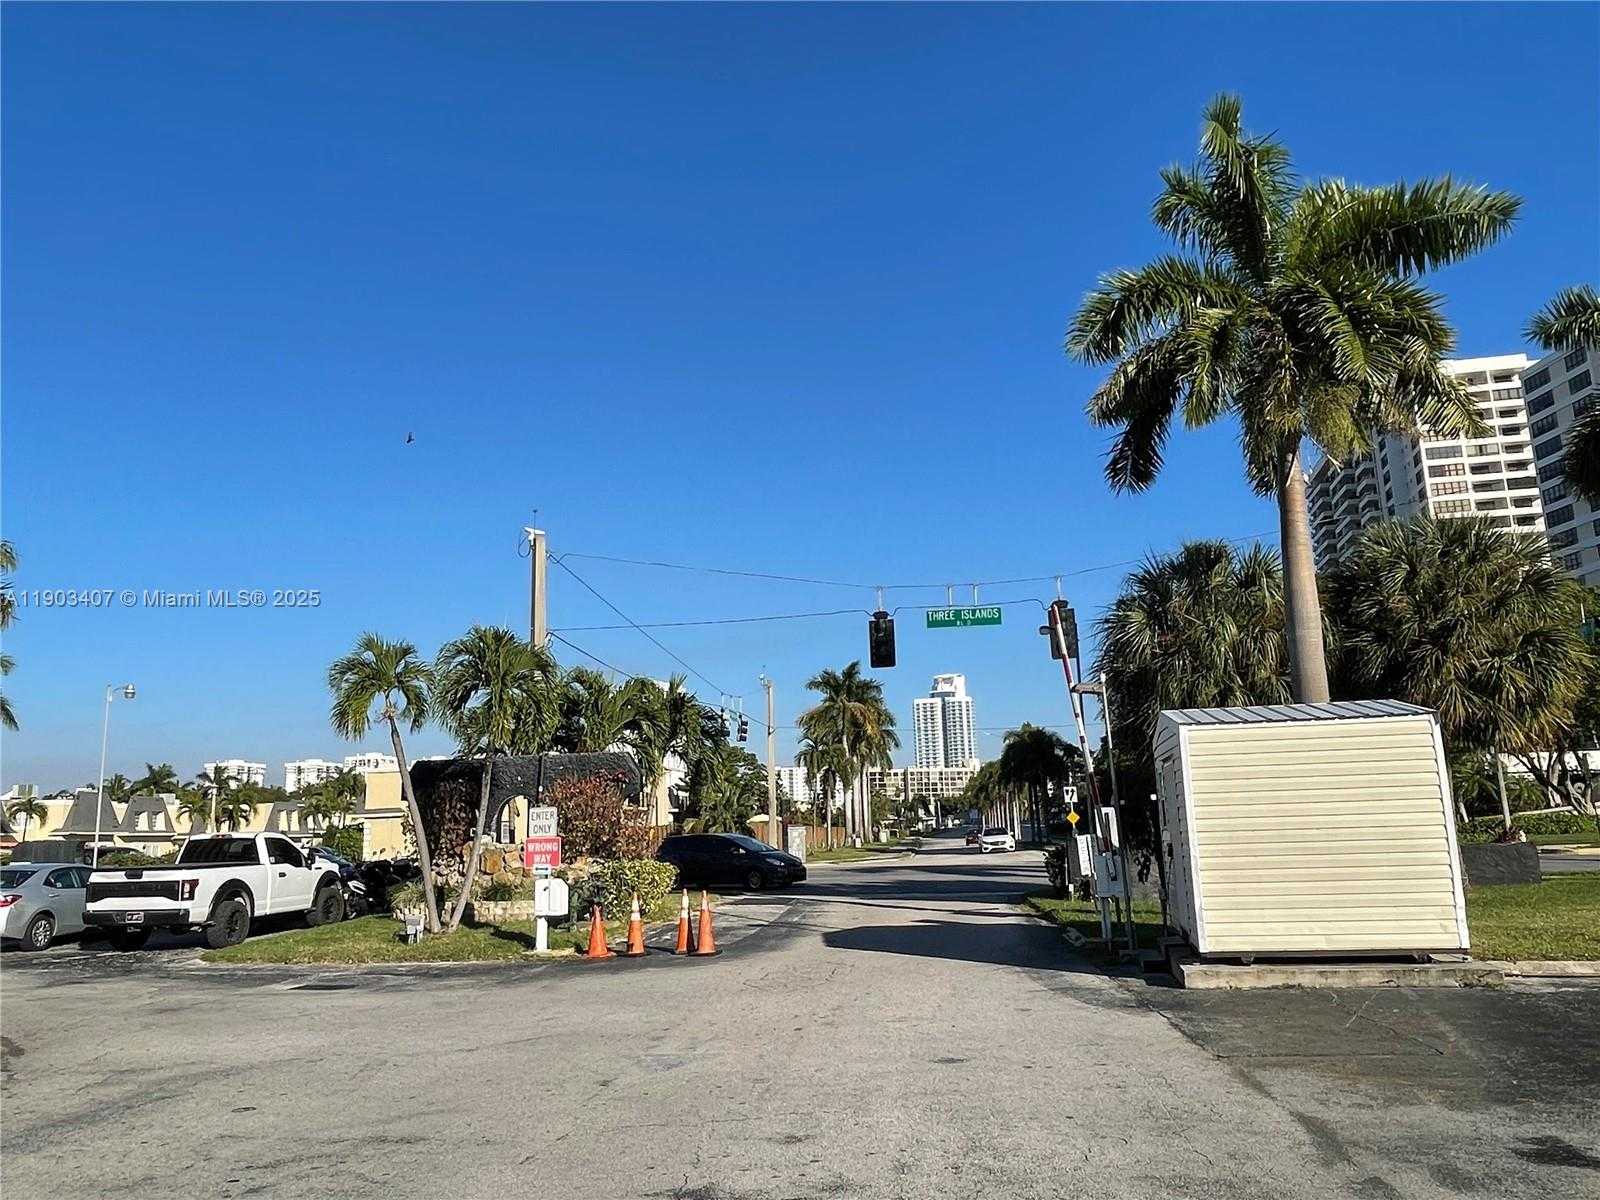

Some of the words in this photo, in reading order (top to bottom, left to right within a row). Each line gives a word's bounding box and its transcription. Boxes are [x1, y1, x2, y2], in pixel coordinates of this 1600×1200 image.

[928, 610, 956, 621] THREE
[961, 608, 999, 619] ISLANDS
[531, 811, 555, 821] ENTER
[533, 823, 551, 834] ONLY
[527, 842, 558, 852] WRONG
[533, 853, 551, 864] WAY
